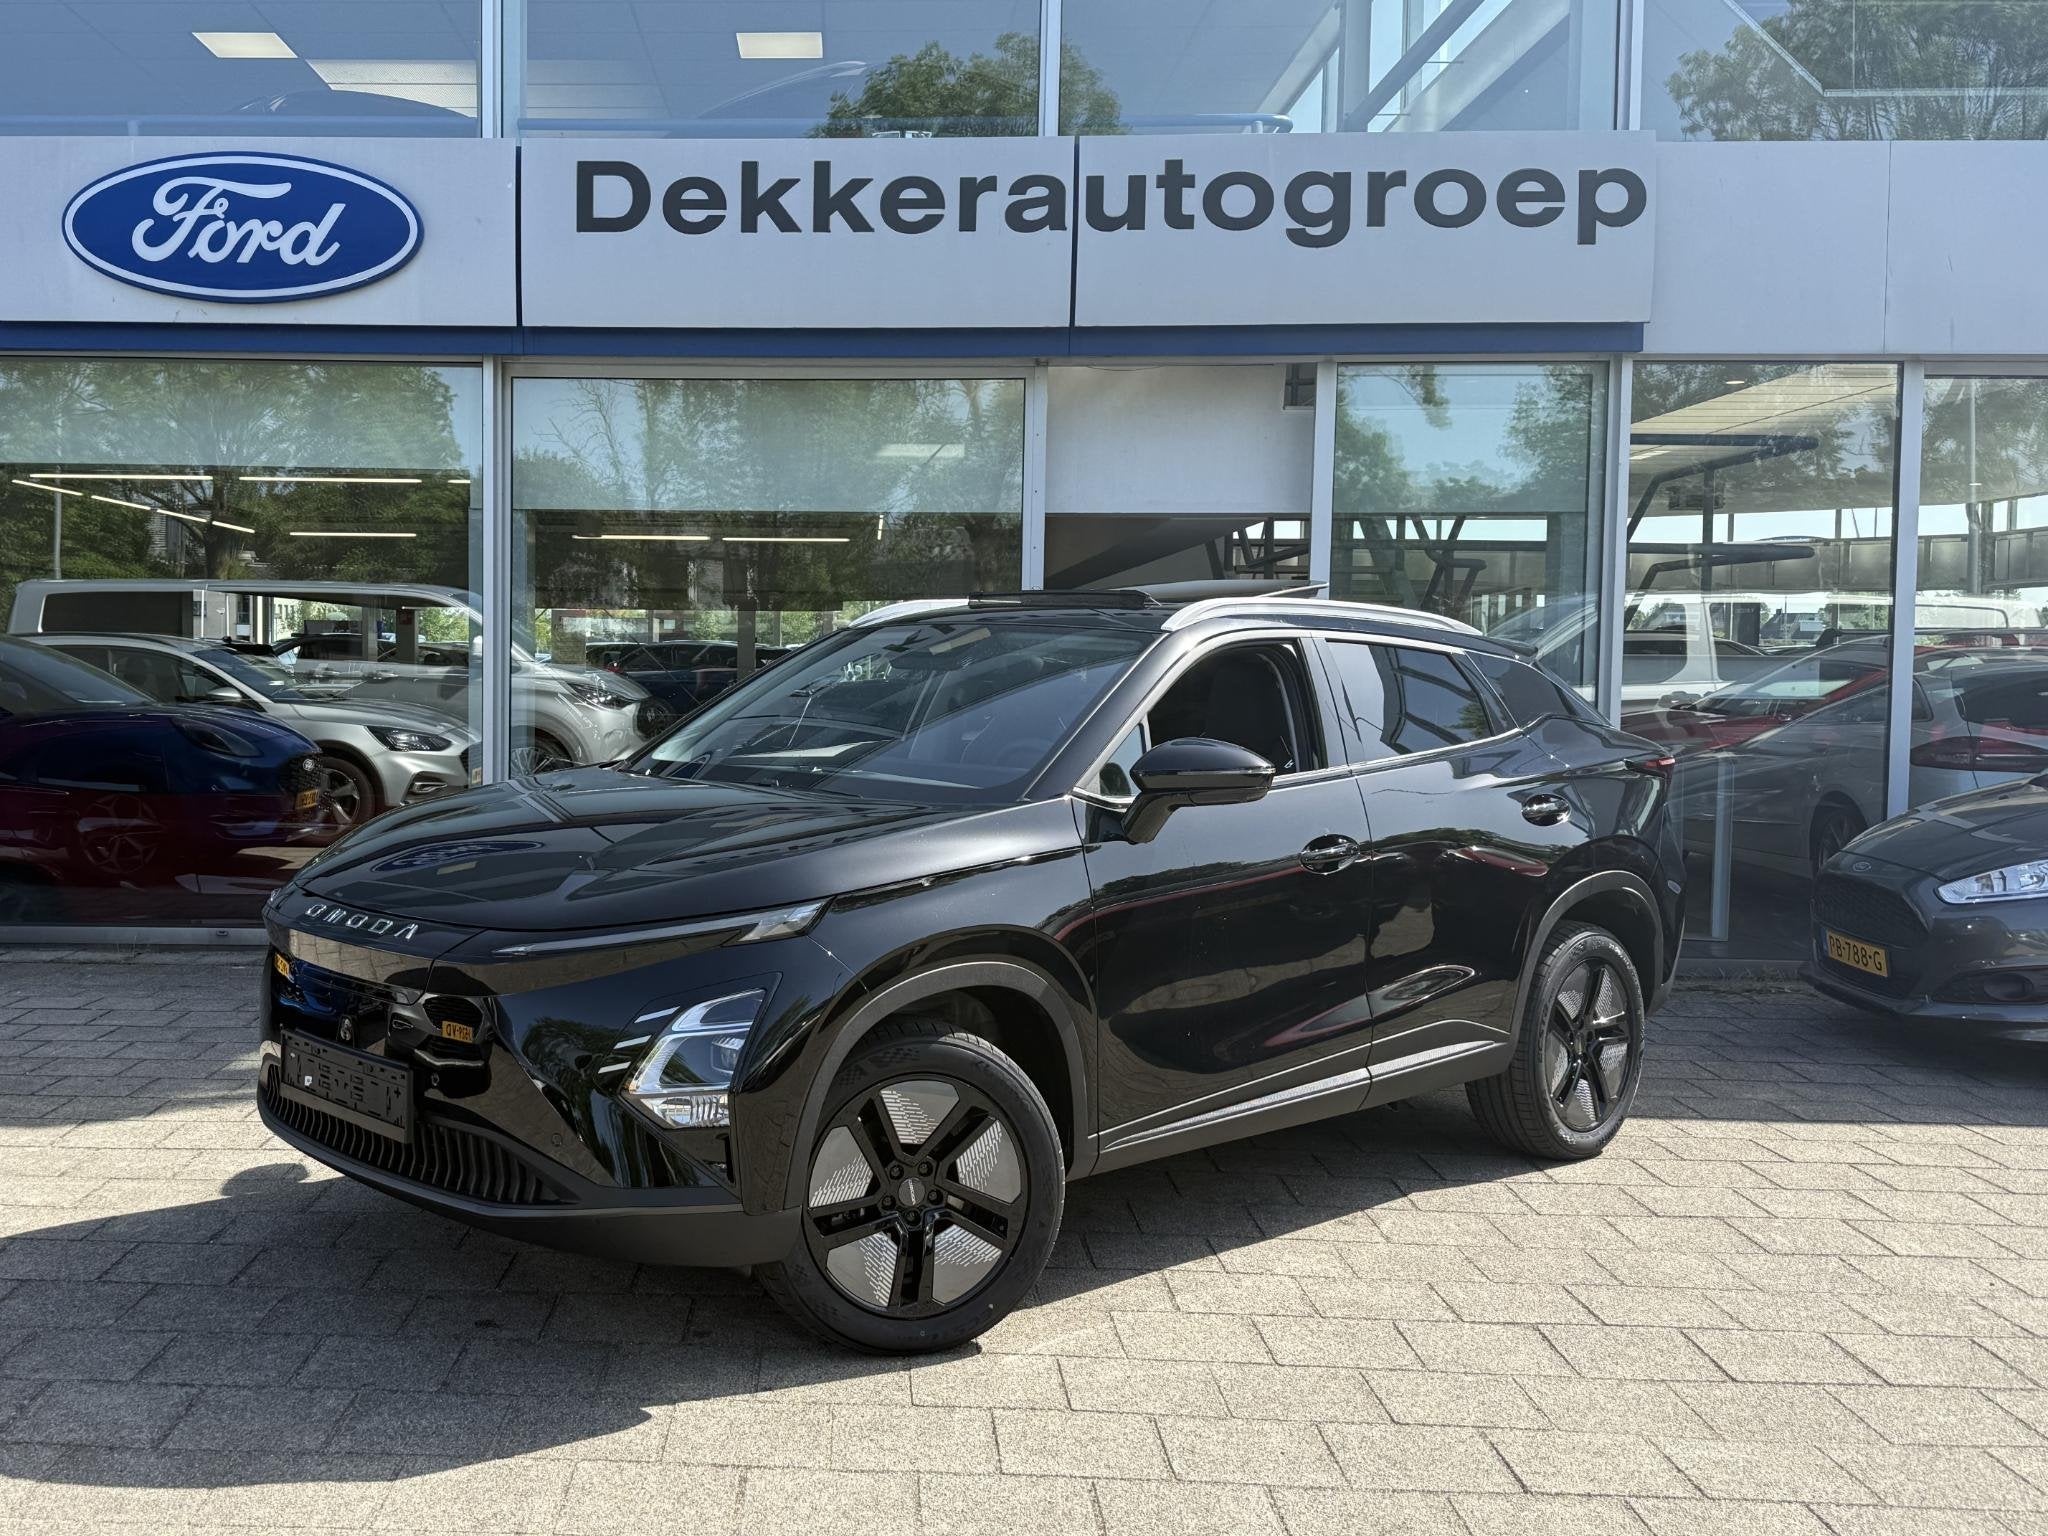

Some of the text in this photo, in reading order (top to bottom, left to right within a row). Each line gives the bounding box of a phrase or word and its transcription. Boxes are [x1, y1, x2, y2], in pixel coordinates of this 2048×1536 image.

[131, 175, 347, 266] Ford
[575, 158, 1648, 248] Dekkerautogroep
[304, 903, 419, 940] OMODA
